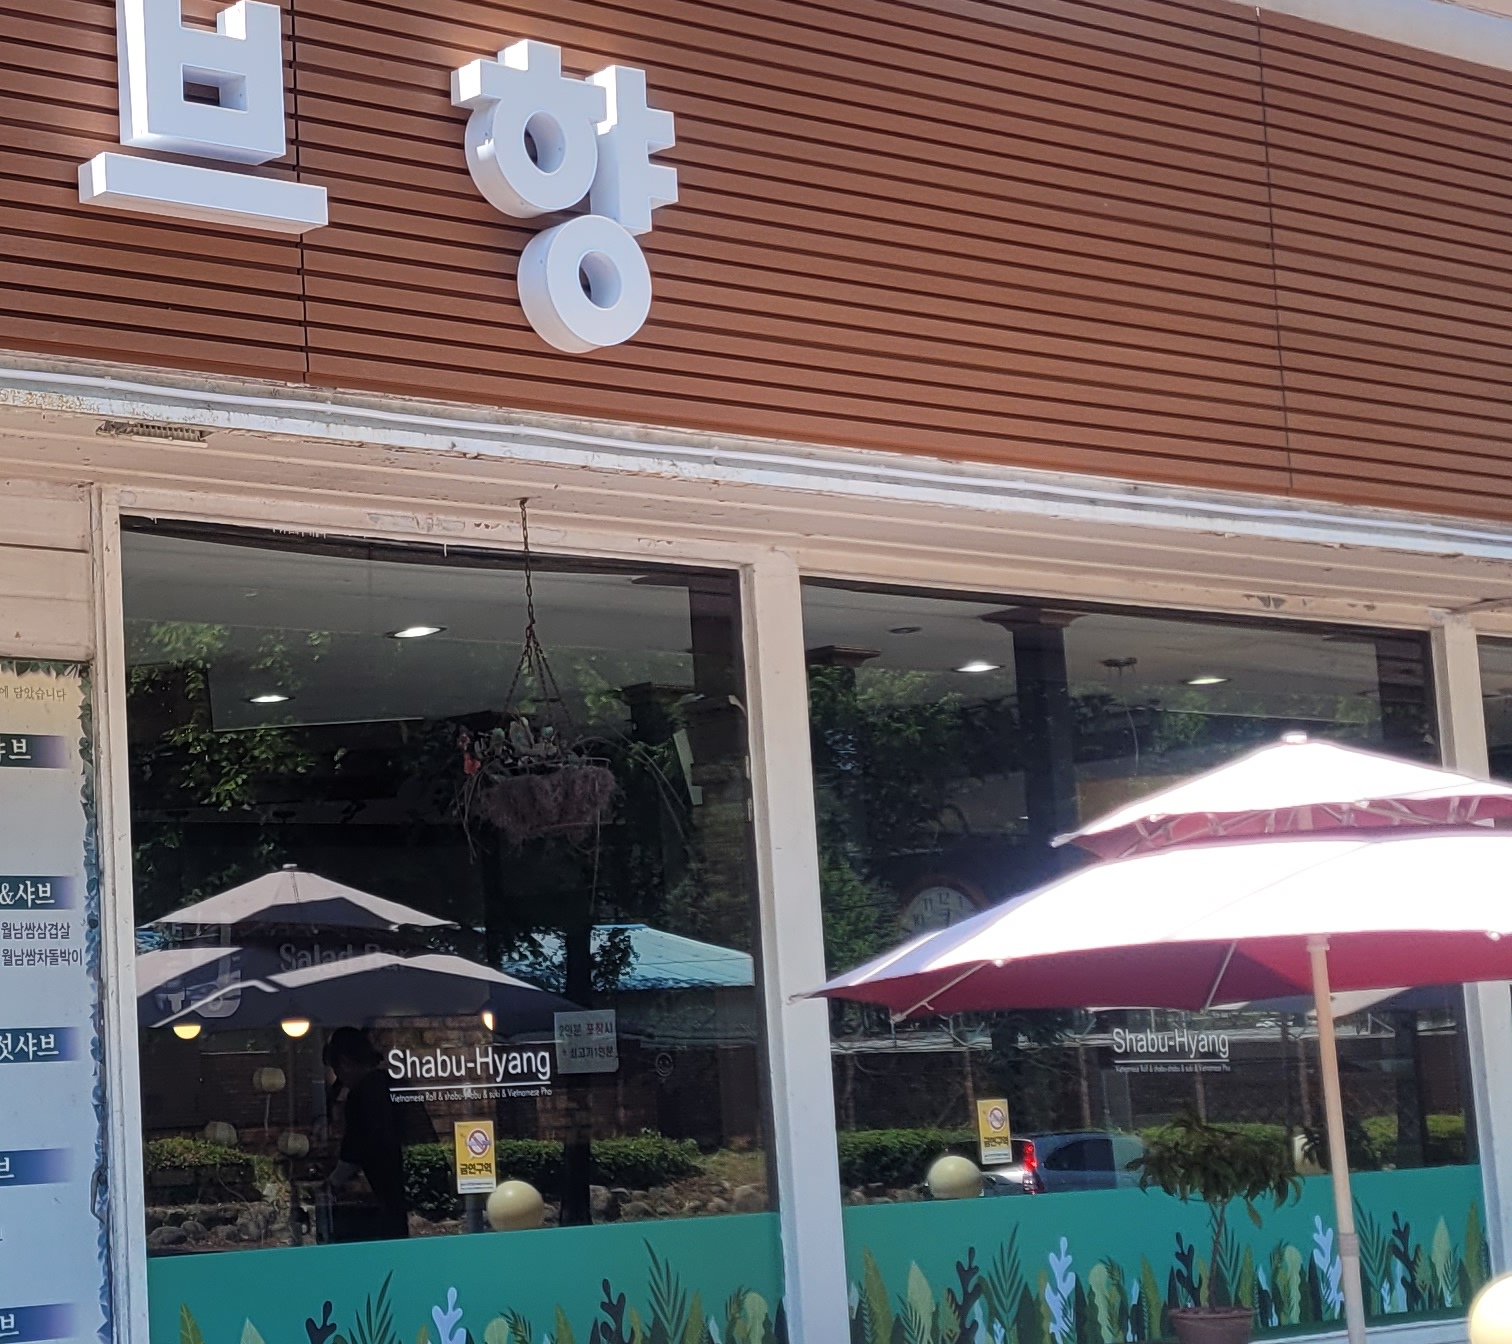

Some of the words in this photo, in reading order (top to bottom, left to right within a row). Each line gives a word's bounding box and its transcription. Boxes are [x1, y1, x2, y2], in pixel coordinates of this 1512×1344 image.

[14, 688, 66, 702] 담았습니다
[1113, 1028, 1229, 1058] Shabu-Hyang
[388, 1047, 551, 1083] Shabu-Hyang
[460, 1162, 492, 1175] 금연구역
